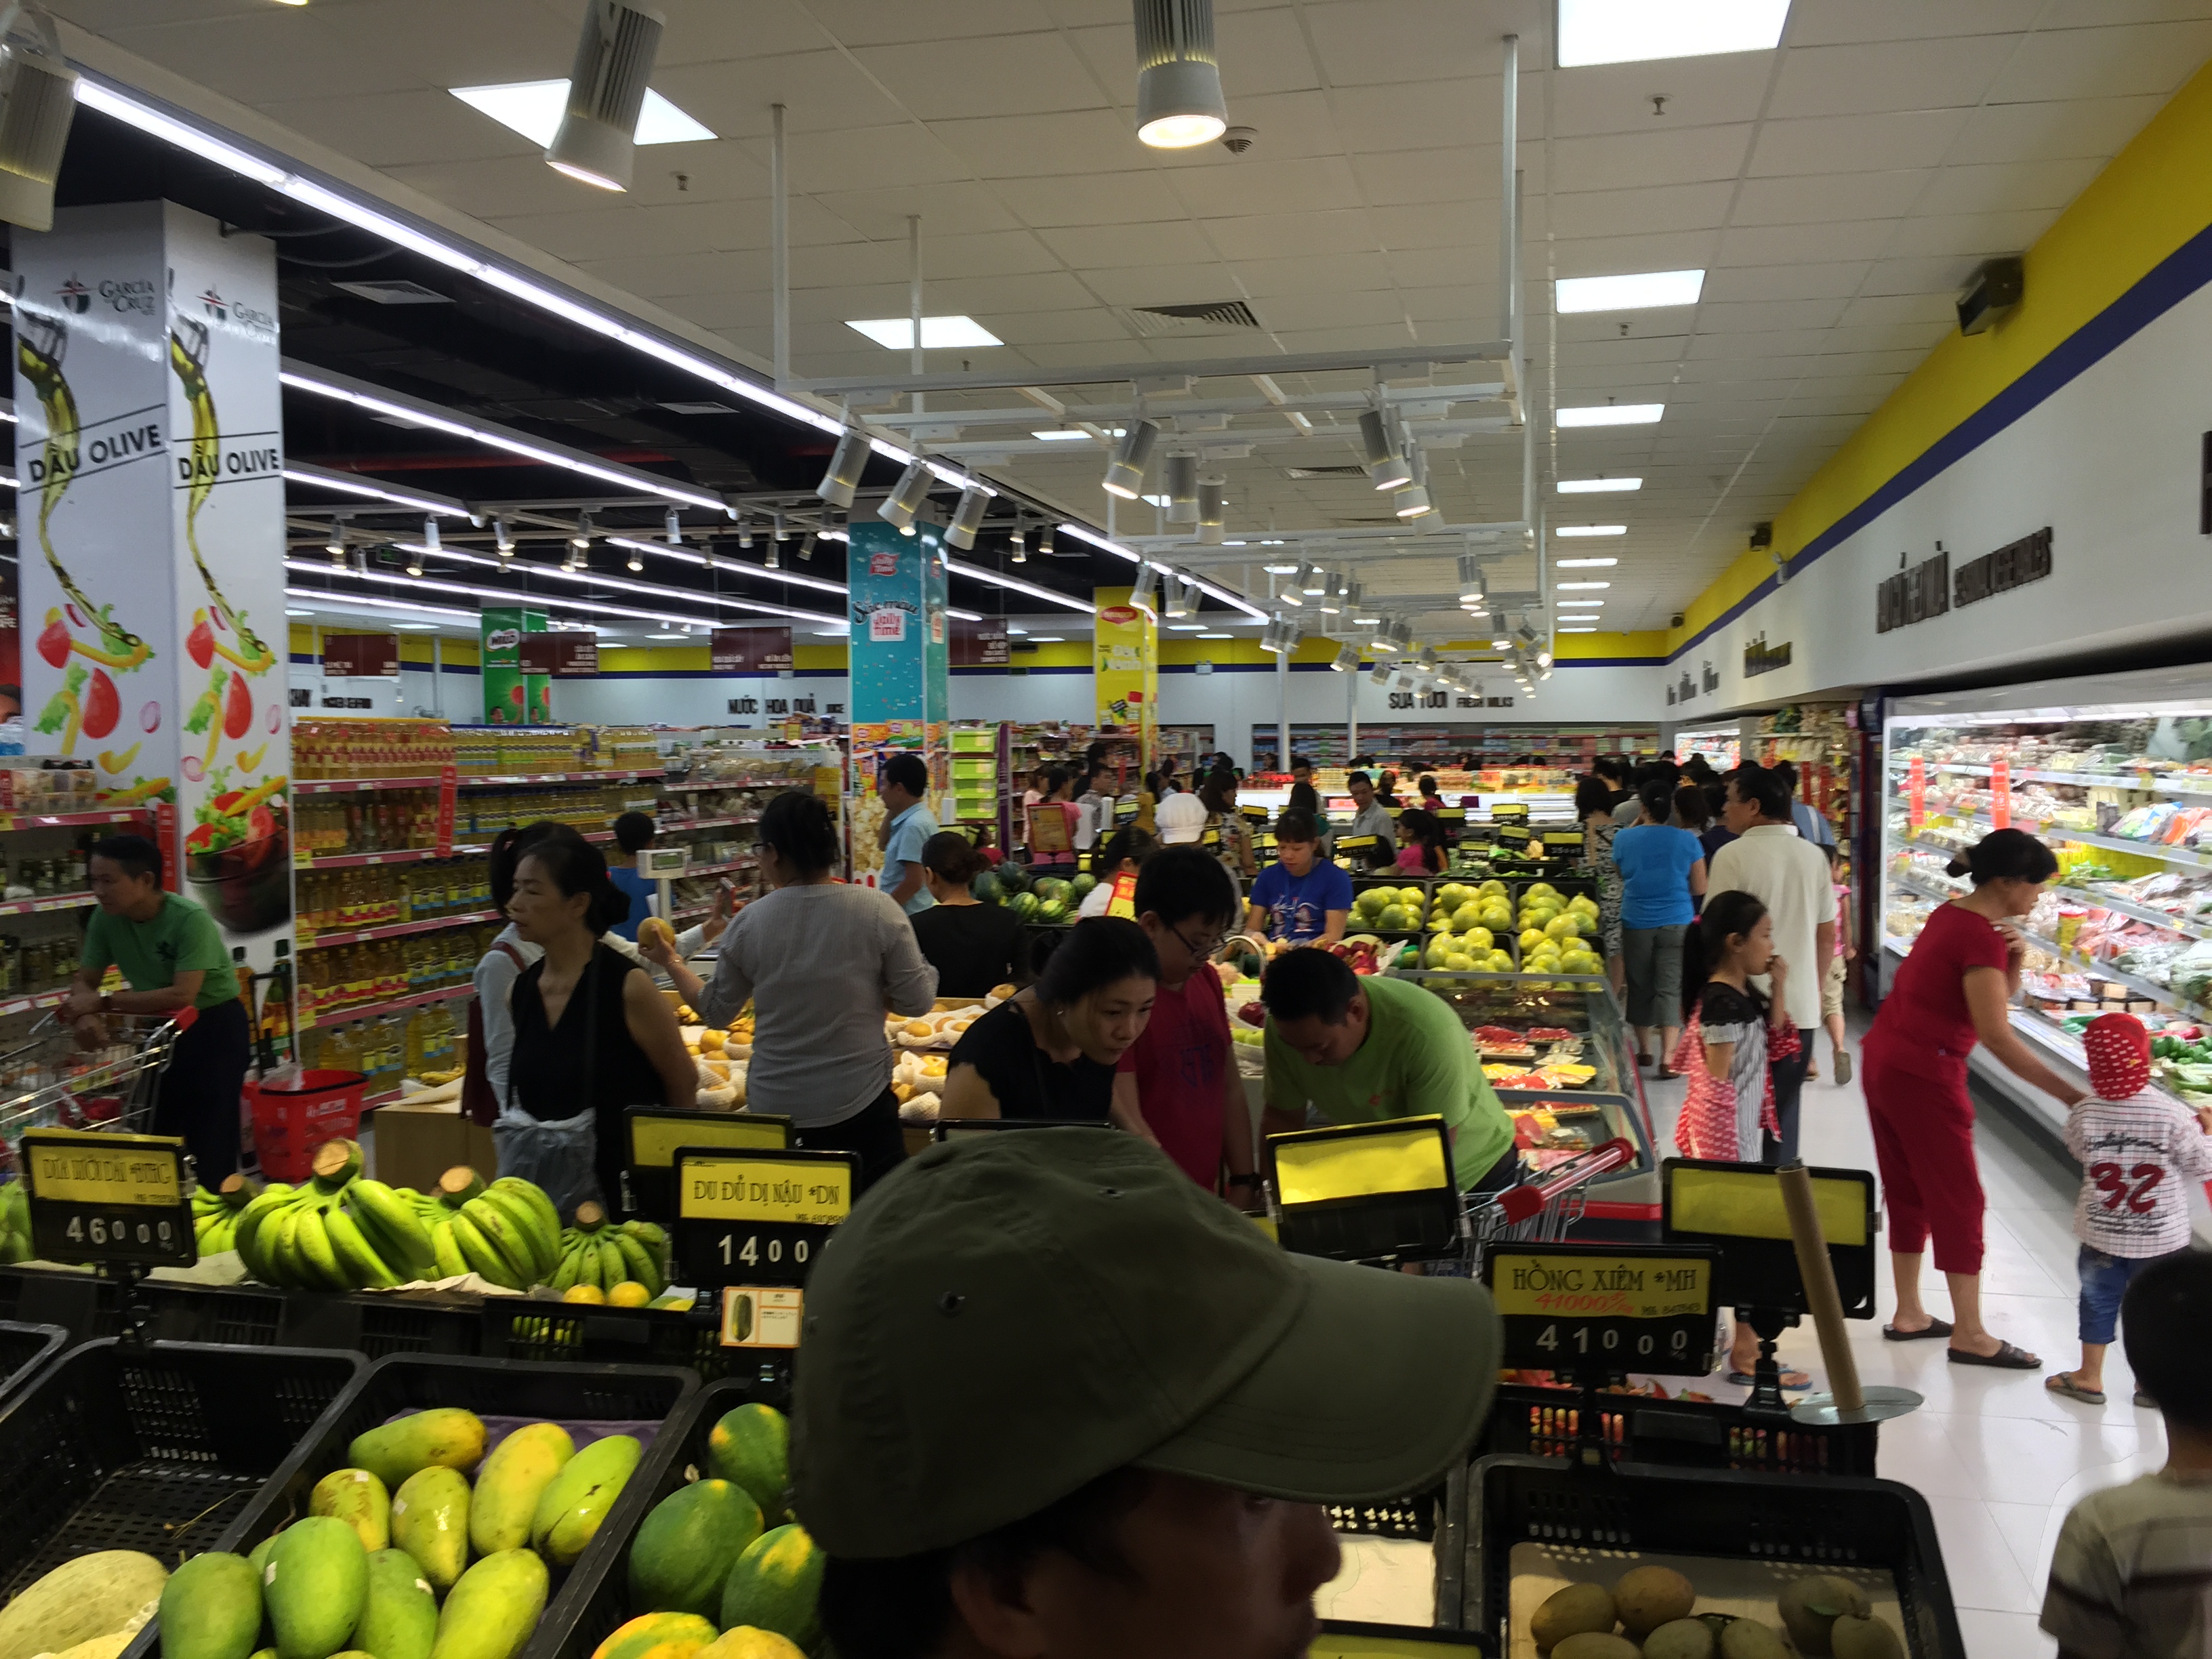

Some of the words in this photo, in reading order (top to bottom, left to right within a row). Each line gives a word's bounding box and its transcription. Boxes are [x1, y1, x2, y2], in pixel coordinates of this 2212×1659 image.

[28, 443, 81, 483] DẦU
[89, 424, 162, 464] OLIVE
[178, 445, 220, 480] DẦU
[226, 449, 279, 474] OLIVE
[1512, 1258, 1584, 1292] HỒNG
[1592, 1263, 1645, 1292] XIÊM
